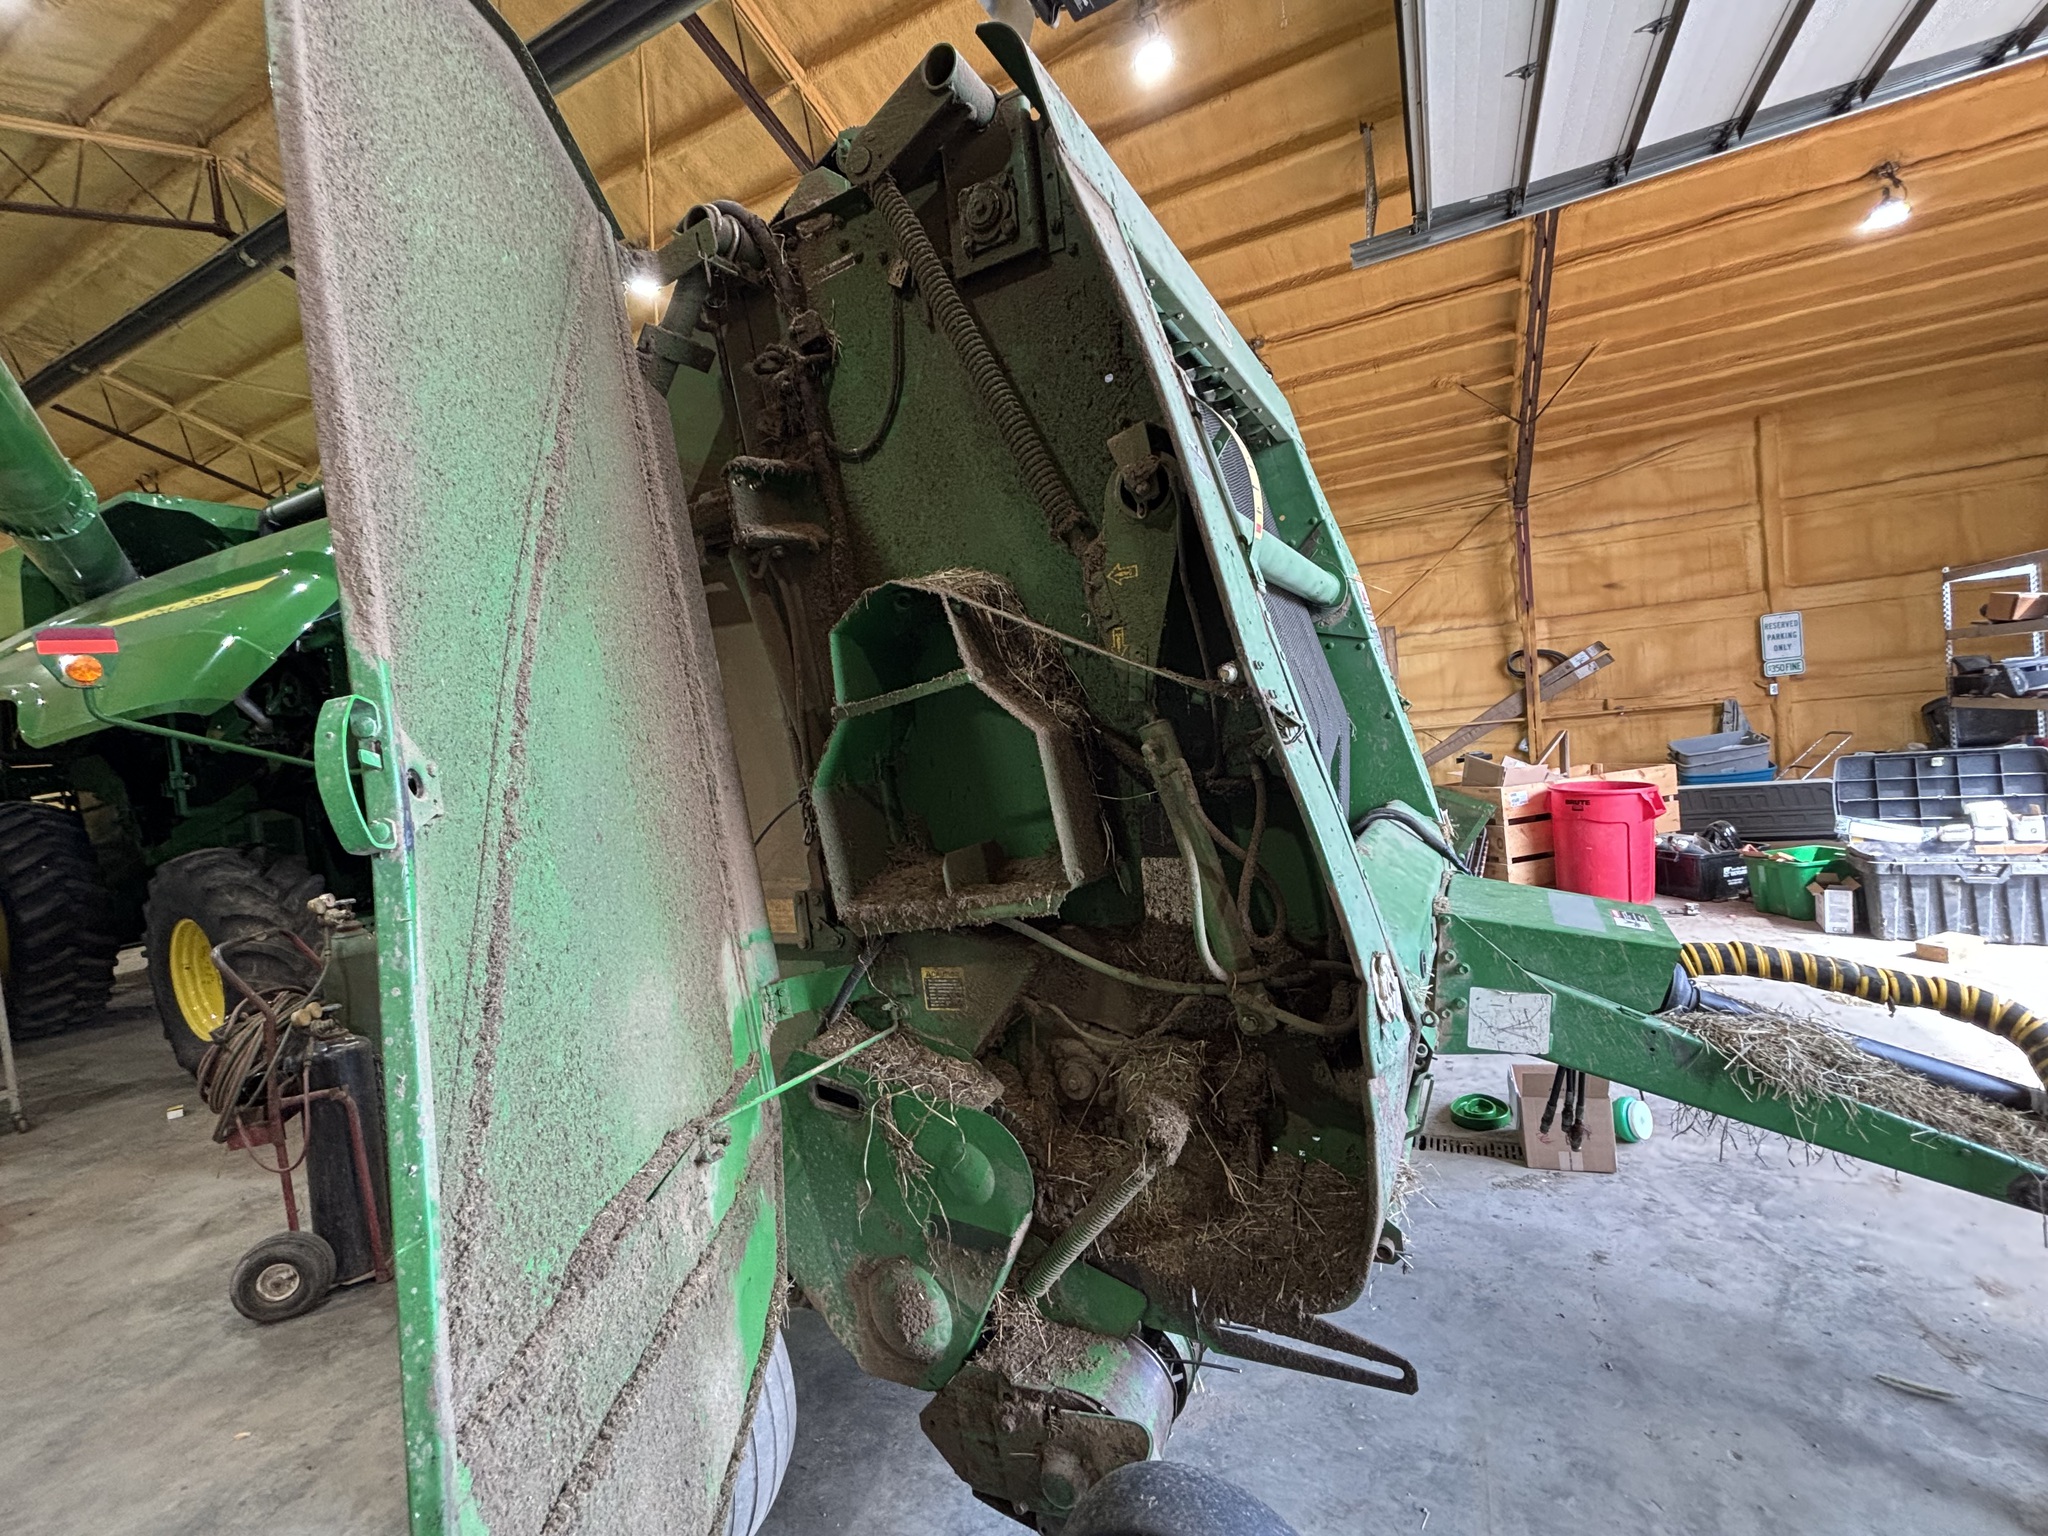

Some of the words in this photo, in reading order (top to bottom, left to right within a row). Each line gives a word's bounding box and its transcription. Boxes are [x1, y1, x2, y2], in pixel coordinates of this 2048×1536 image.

[1764, 620, 1799, 630] RESERVED
[1767, 631, 1797, 641] PARKING
[1773, 643, 1792, 652] ONLY
[1767, 664, 1785, 673] $350
[1785, 662, 1801, 671] FINE
